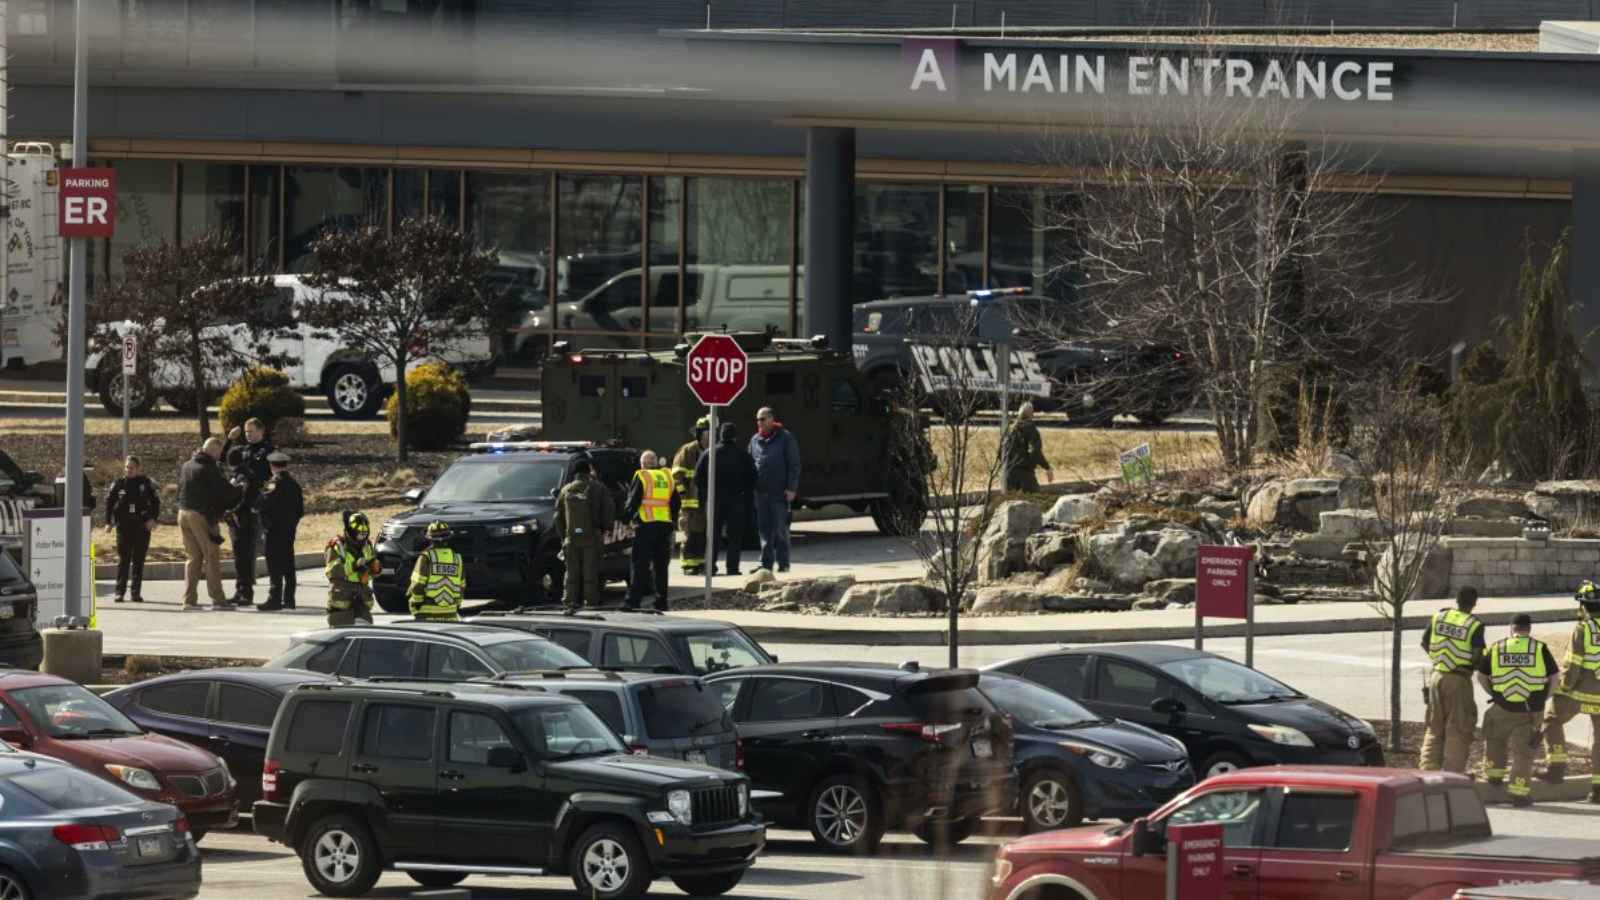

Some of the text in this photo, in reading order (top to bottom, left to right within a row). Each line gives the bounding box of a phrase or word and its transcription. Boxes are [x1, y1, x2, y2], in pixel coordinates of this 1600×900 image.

[910, 48, 1394, 101] A MAIN ENTRANCE
[65, 178, 110, 188] PARKING
[65, 197, 108, 224] ER
[691, 356, 743, 383] STOP
[911, 345, 1047, 384] POLICE
[1201, 556, 1242, 567] EMERGENCY
[1207, 568, 1238, 577] PARKING
[1212, 579, 1231, 587] ONLY
[1503, 655, 1530, 665] R505
